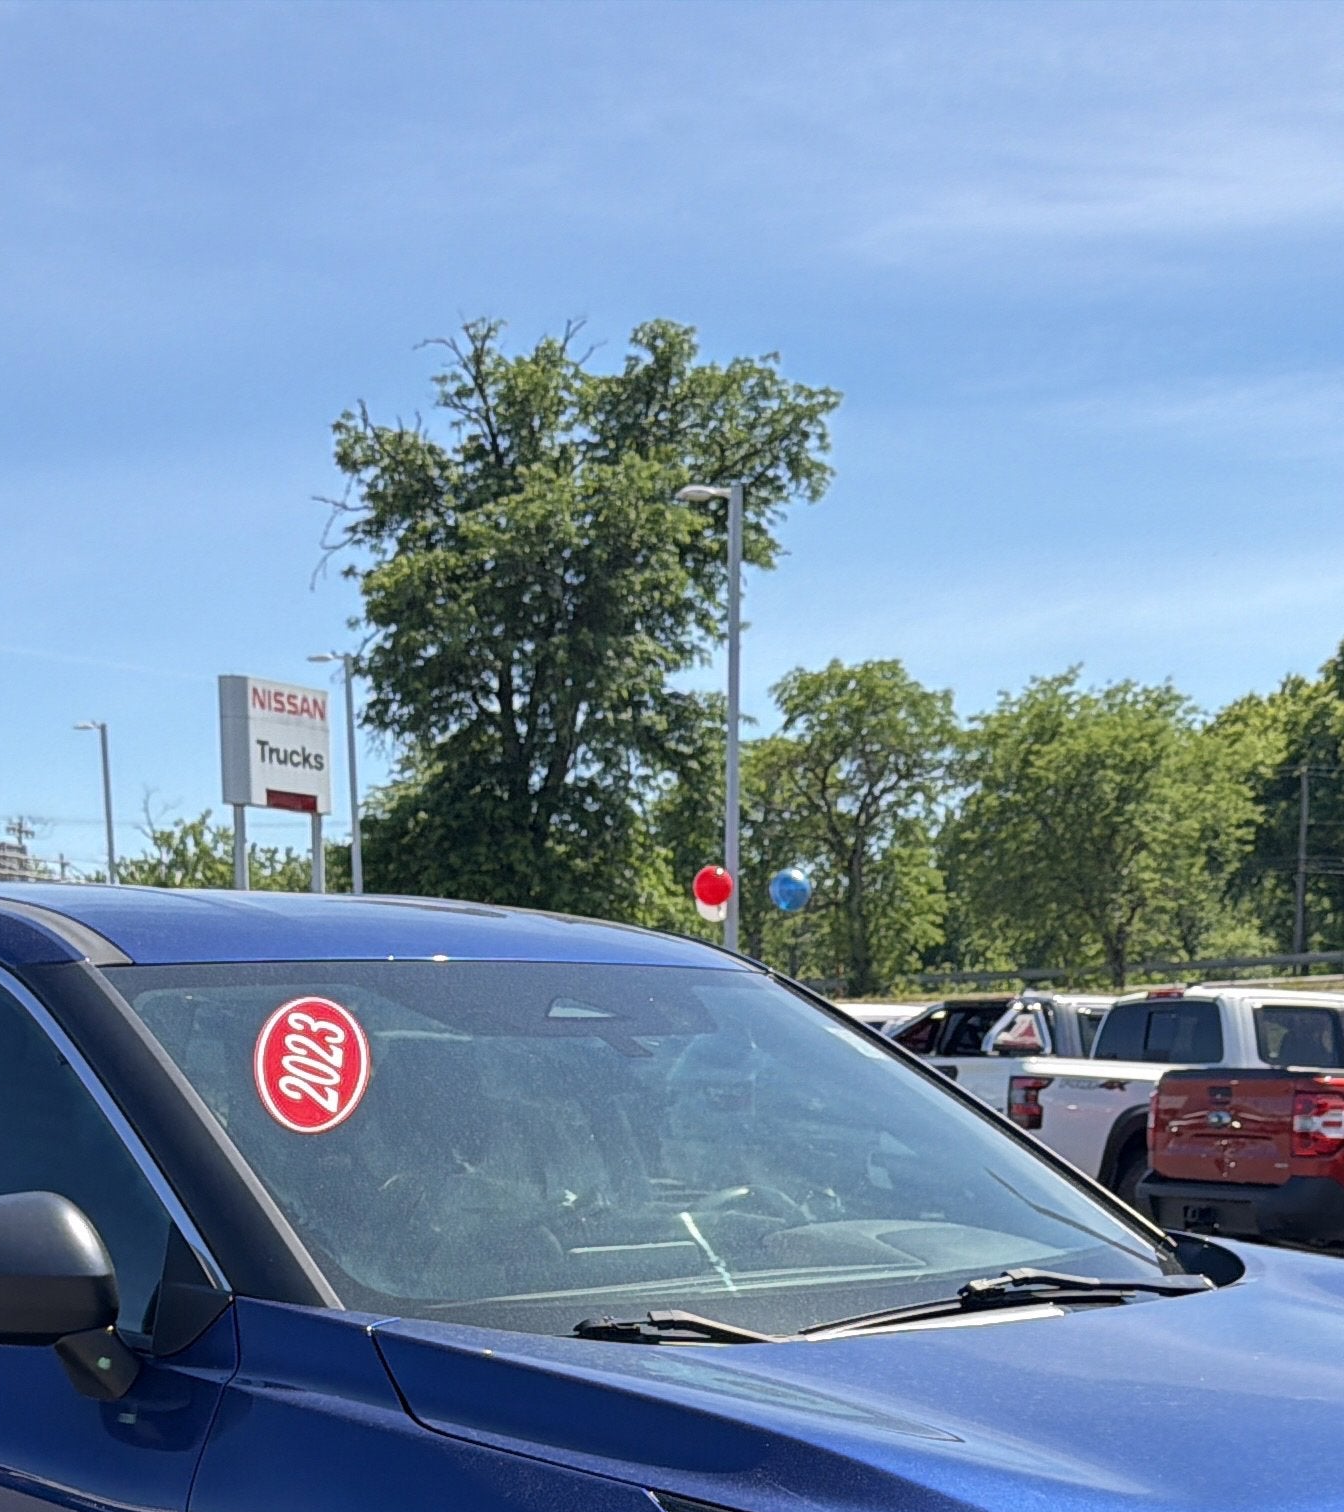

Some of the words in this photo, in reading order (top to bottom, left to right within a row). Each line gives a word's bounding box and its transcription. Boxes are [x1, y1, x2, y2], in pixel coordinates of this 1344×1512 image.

[252, 687, 327, 721] NISSAN
[256, 739, 325, 772] Trucks
[278, 1011, 345, 1113] 2023
